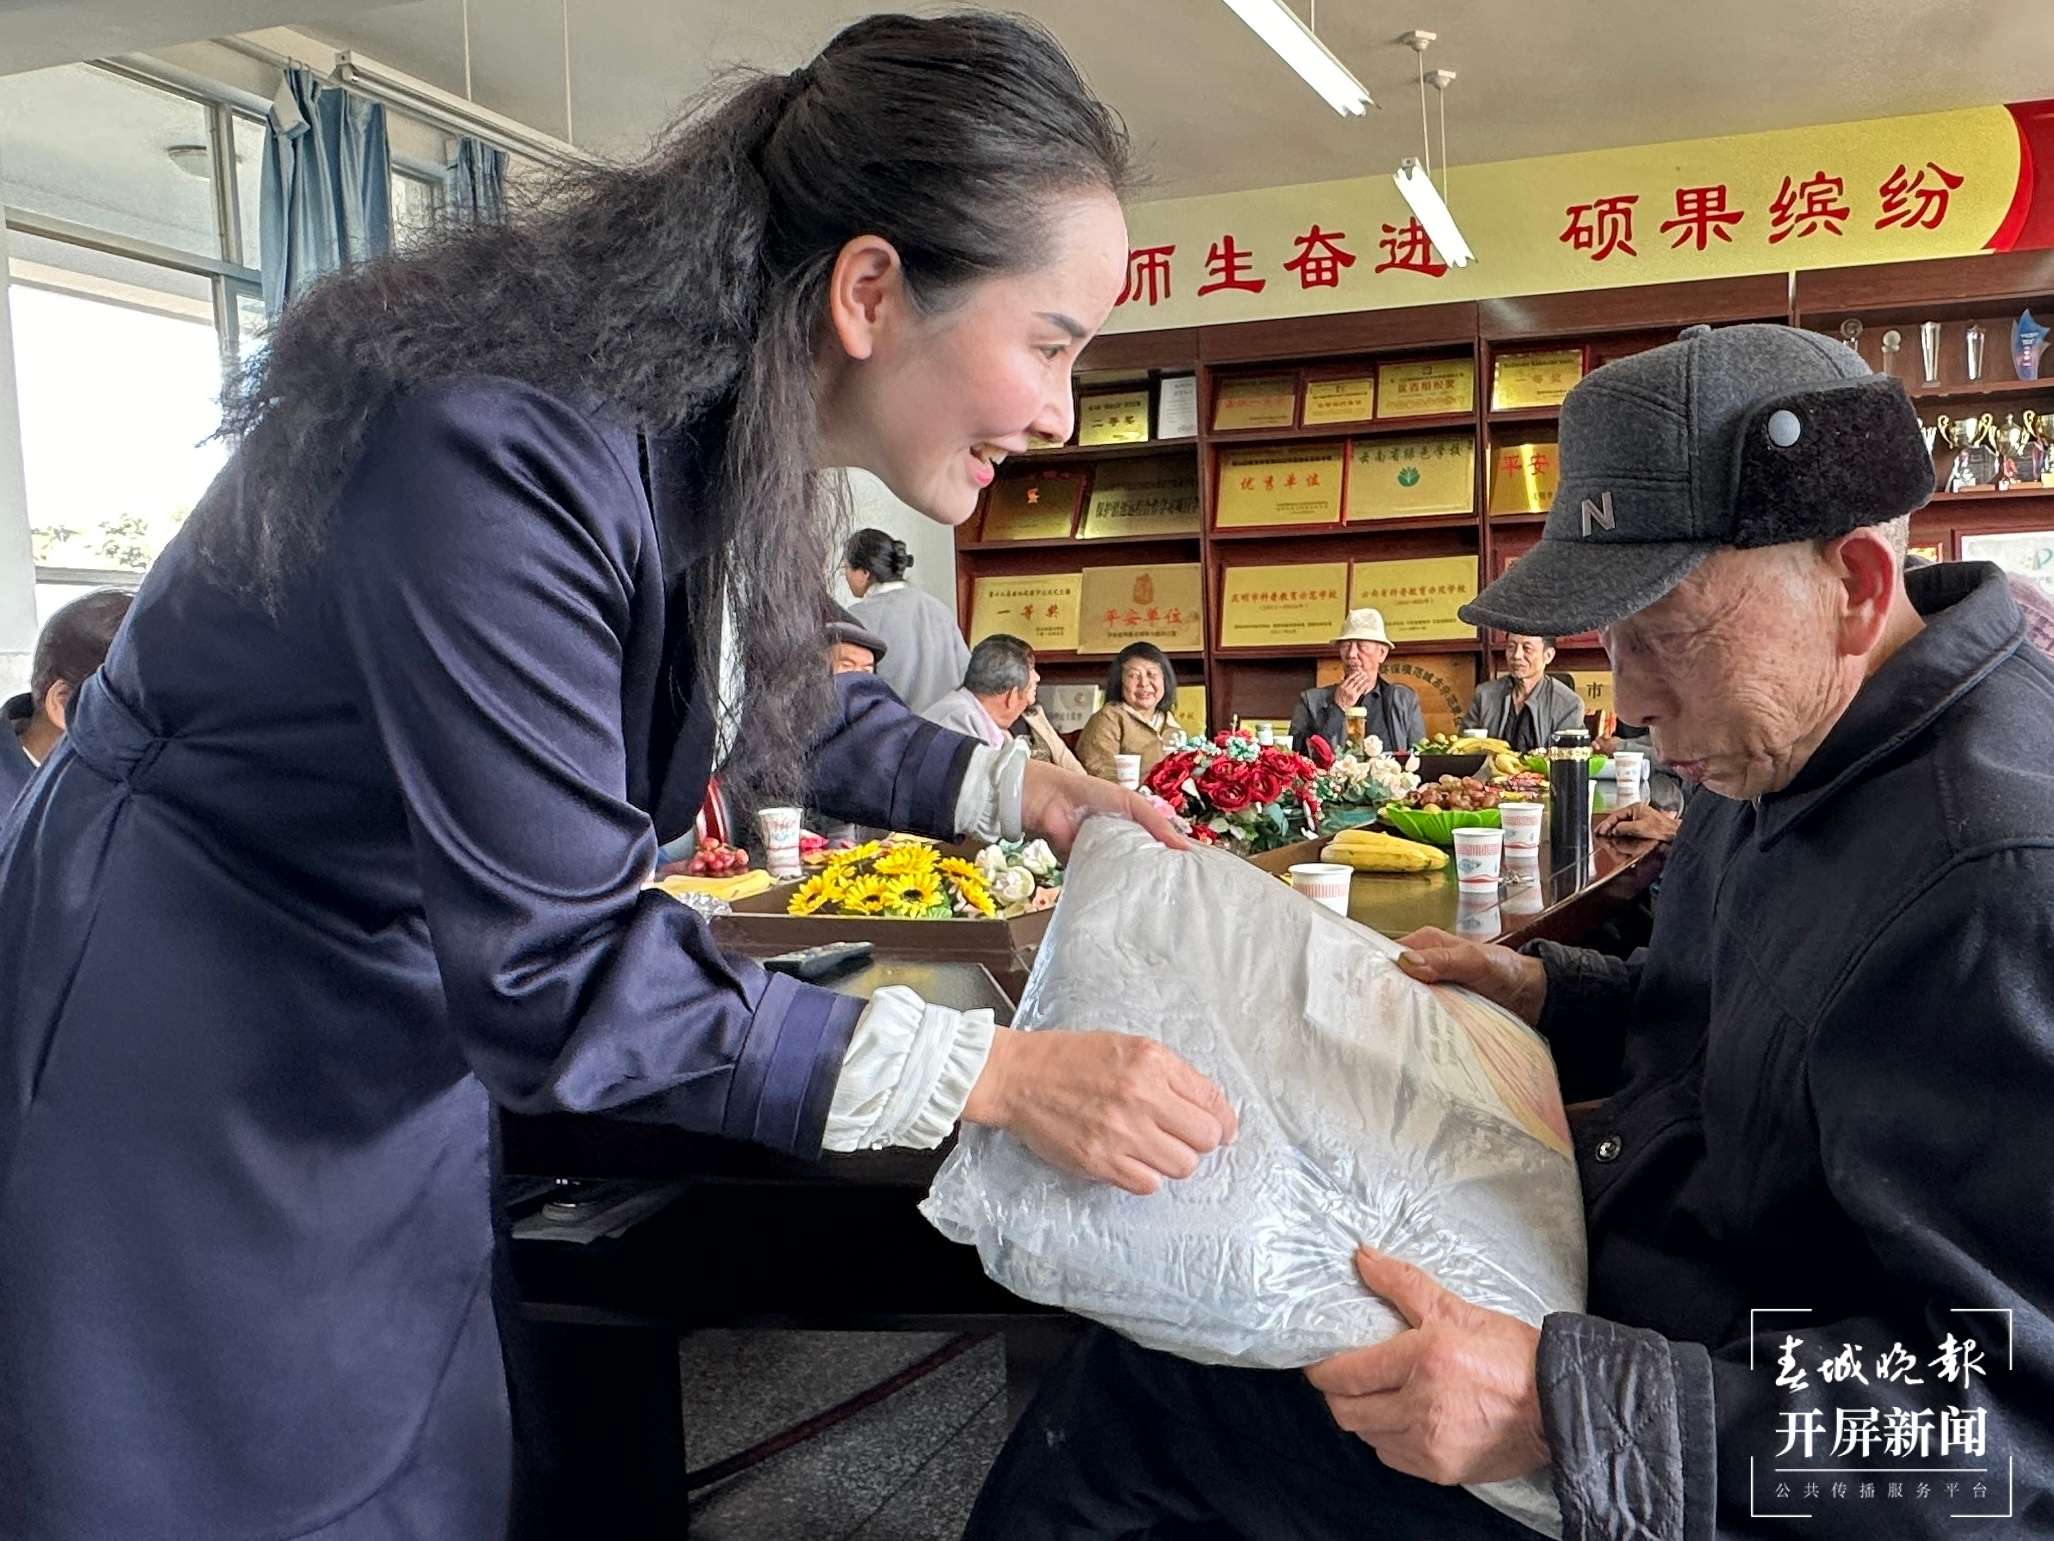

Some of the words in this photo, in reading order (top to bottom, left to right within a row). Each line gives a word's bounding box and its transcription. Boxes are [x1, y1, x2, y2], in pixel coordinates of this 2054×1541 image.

[1559, 161, 1966, 262] 硕果缤纷
[1503, 452, 1550, 478] 平安
[1581, 490, 1616, 537] N
